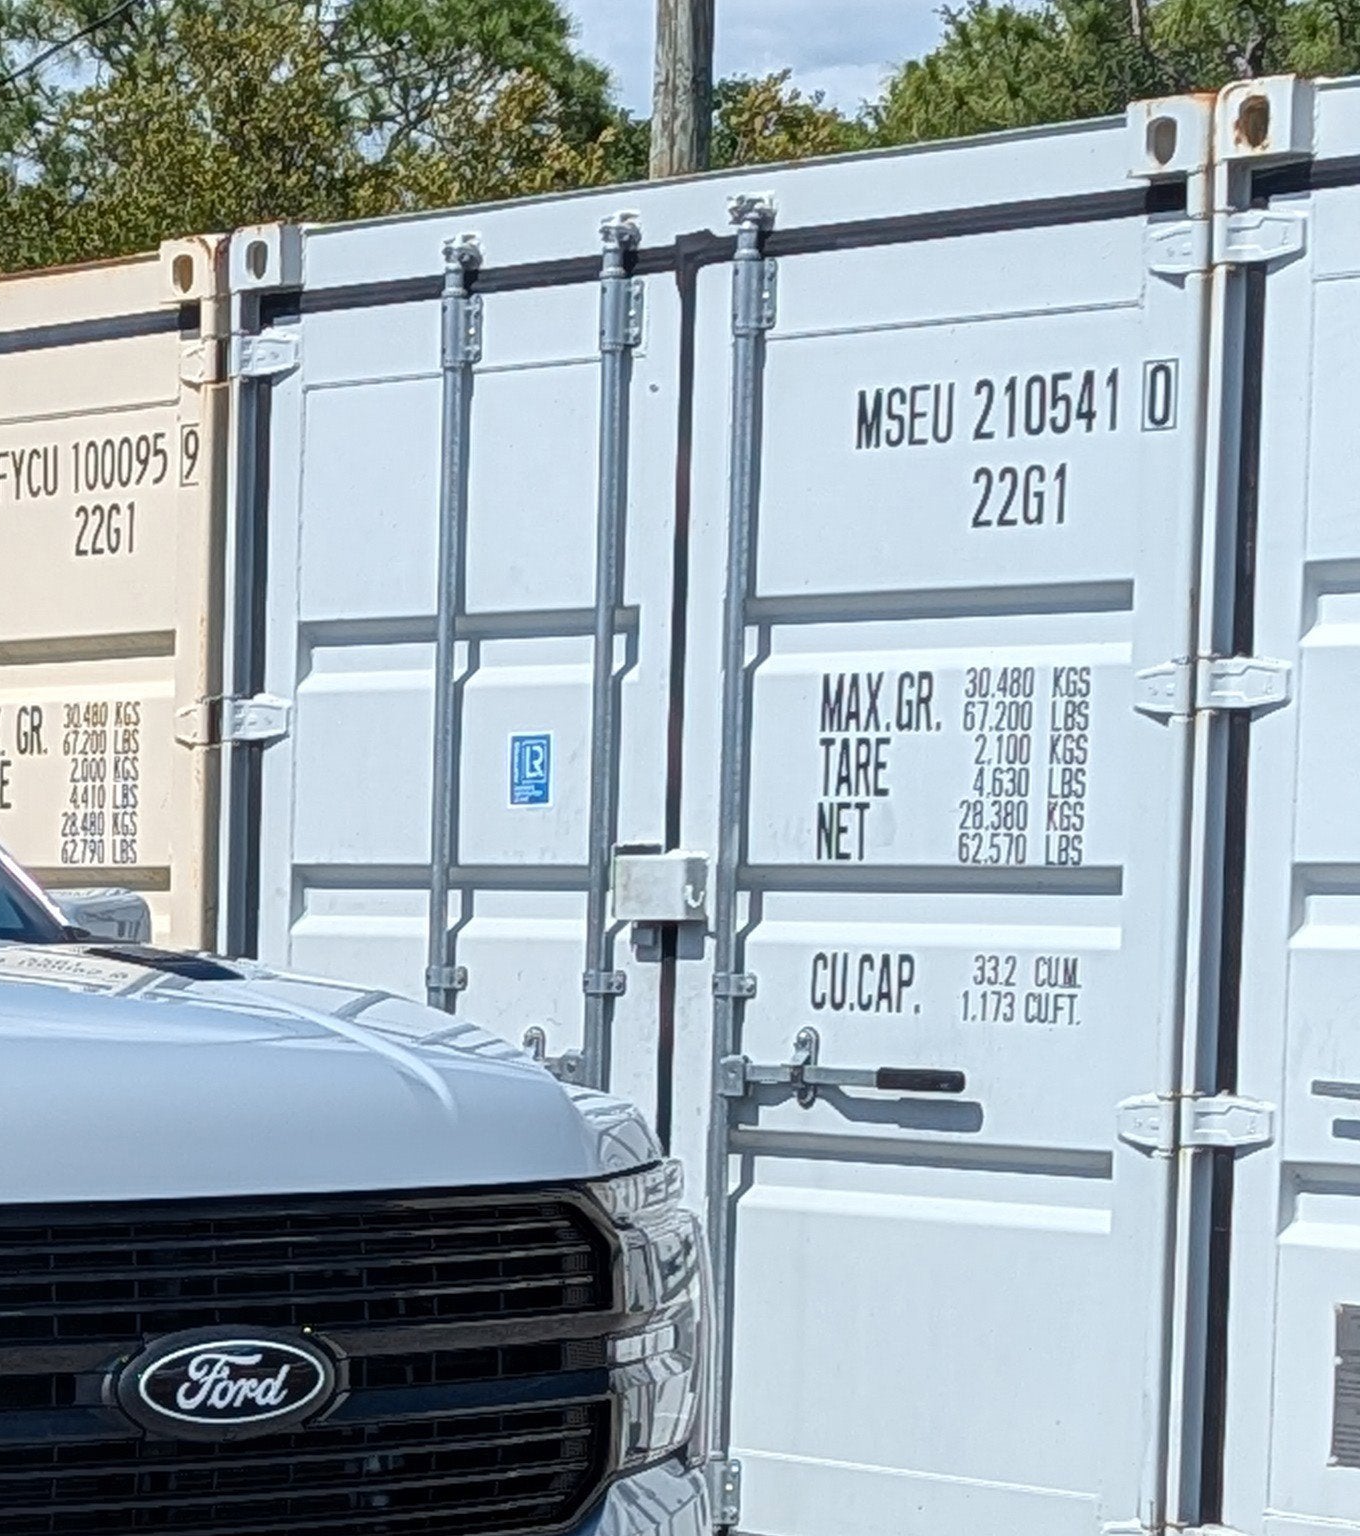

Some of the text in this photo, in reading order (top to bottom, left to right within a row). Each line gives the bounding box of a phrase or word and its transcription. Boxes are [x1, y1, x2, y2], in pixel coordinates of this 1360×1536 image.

[856, 363, 1173, 450] MSEU 210541 0
[71, 432, 169, 494] 100095
[183, 429, 201, 480] 9
[971, 462, 1068, 528] 22G1
[74, 501, 136, 556] 22G1
[1052, 666, 1091, 698] KGS
[16, 704, 49, 757] GR.
[114, 701, 141, 728] KGS
[1051, 700, 1090, 732] LBS
[113, 728, 140, 755] LBS
[112, 756, 139, 782] KGS
[819, 737, 891, 797] TARE
[1049, 733, 1089, 765] KGS
[112, 784, 139, 810] LBS
[1047, 767, 1087, 799] LBS
[111, 811, 138, 837] KGS
[816, 801, 871, 861] NET
[1046, 800, 1085, 832] KGS
[111, 838, 138, 864] LBS
[1044, 833, 1084, 866] LBS
[973, 954, 1017, 986] 33.2
[176, 1353, 290, 1410] Ford
